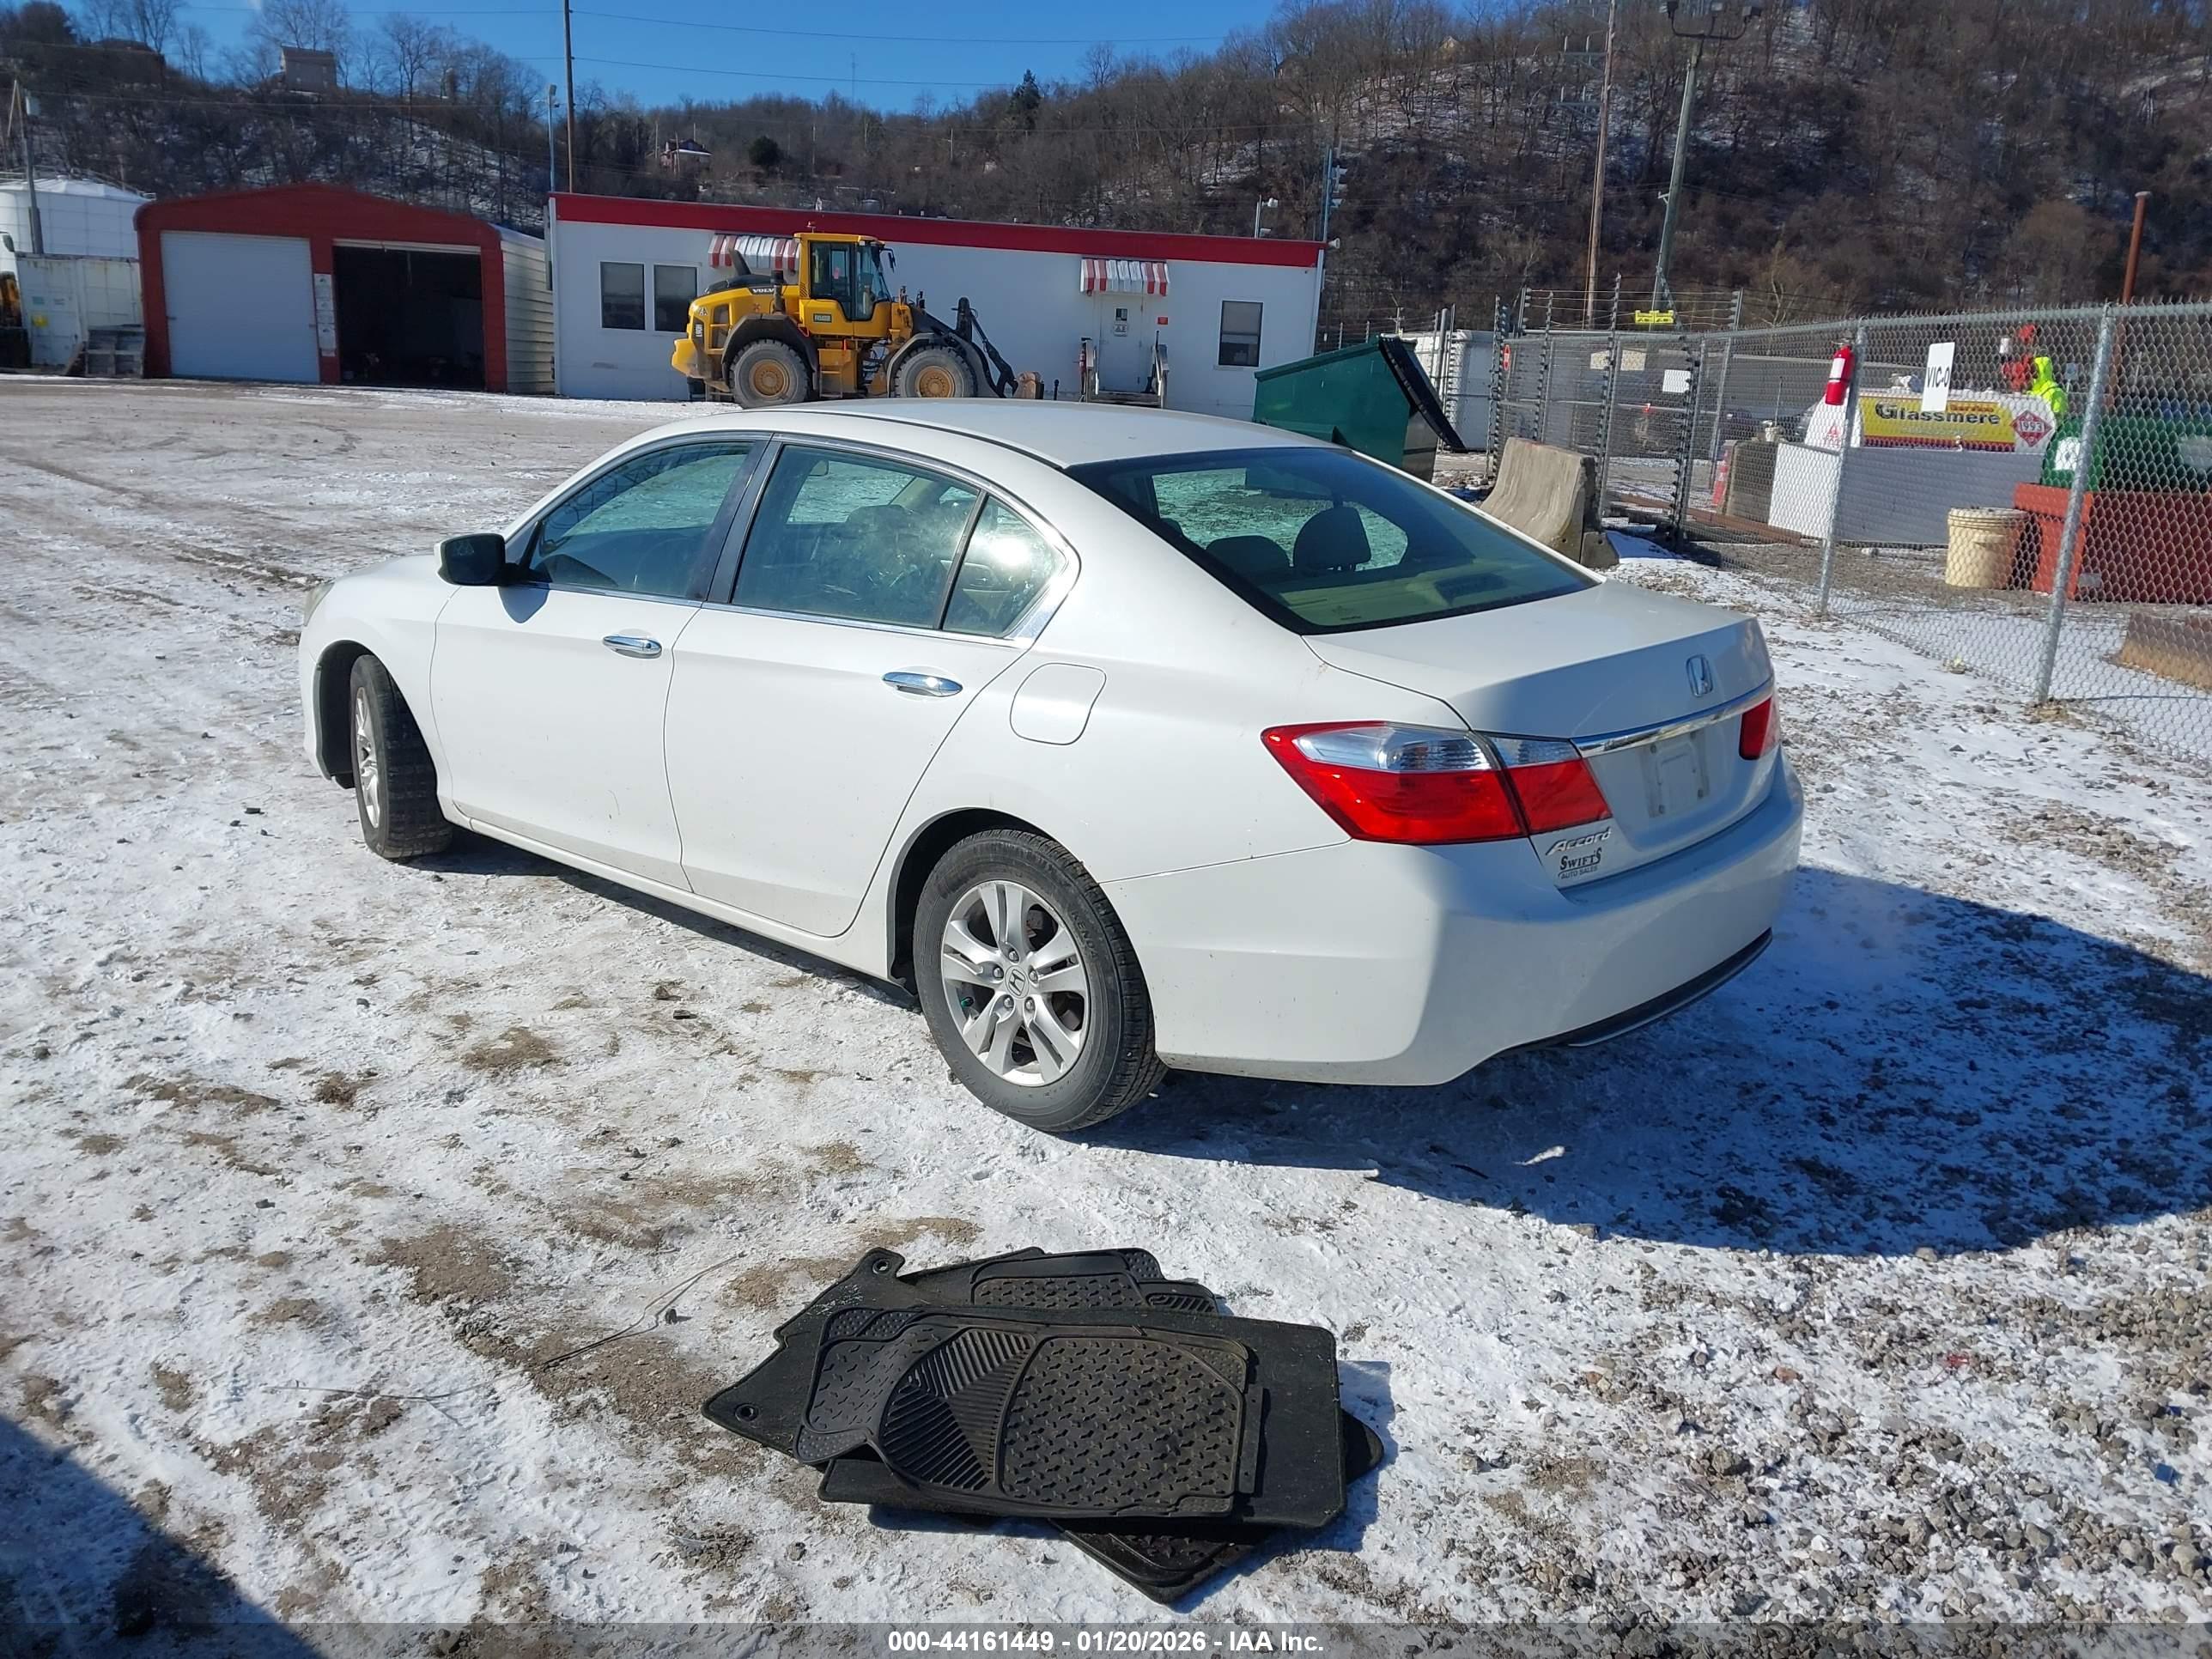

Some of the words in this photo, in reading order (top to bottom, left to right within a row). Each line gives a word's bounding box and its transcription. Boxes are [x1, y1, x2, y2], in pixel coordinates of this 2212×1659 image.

[1875, 400, 2001, 426] Glassmere
[2020, 421, 2042, 431] 1993
[1546, 826, 1612, 856] Accord
[1560, 870, 1578, 880] AUTO
[1579, 866, 1598, 875] SALES
